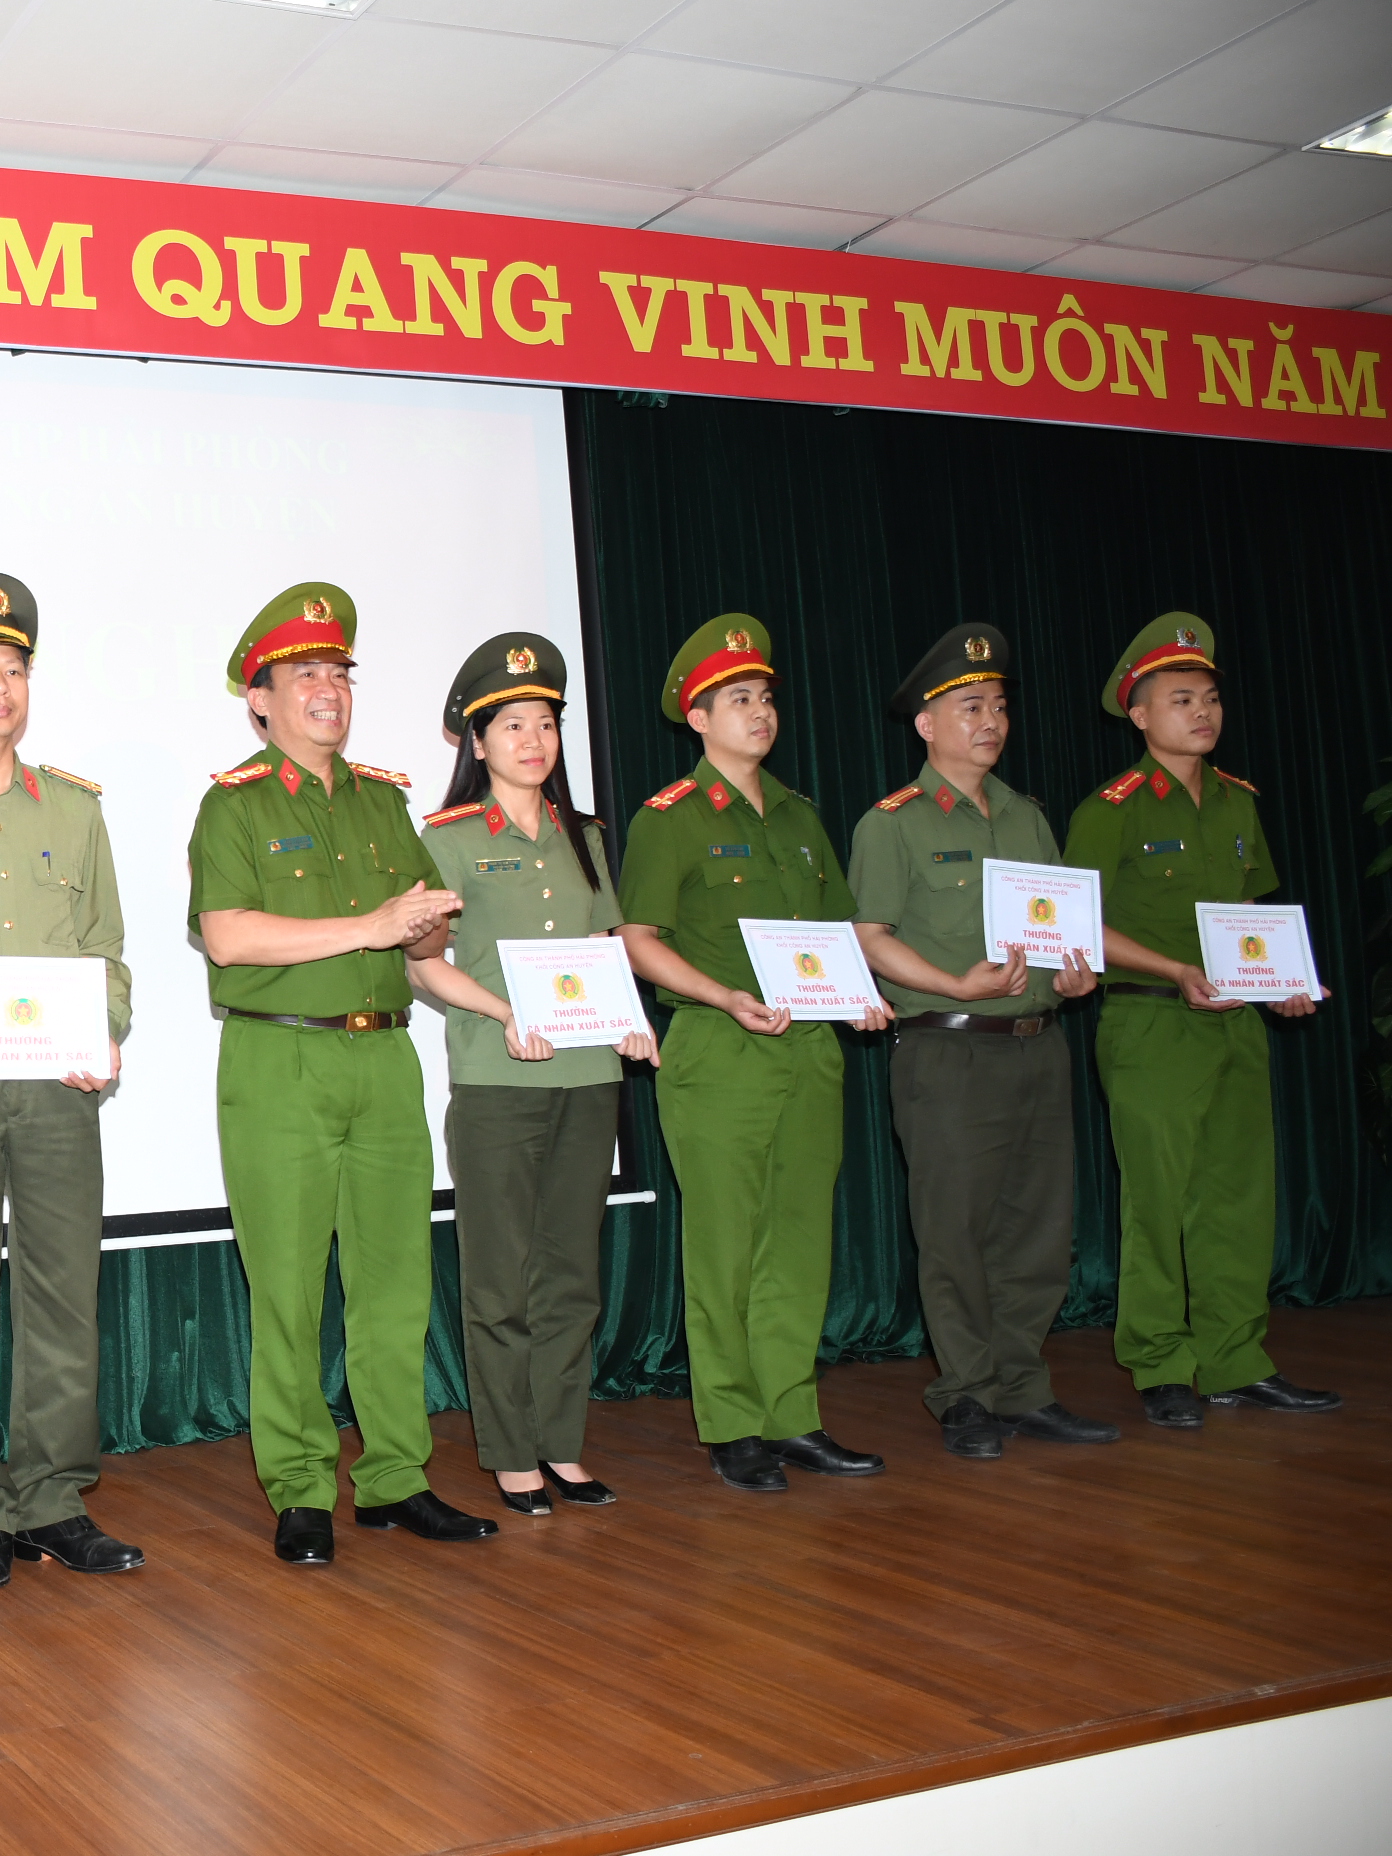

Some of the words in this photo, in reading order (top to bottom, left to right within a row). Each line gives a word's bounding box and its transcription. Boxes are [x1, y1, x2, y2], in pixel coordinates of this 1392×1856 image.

[131, 229, 572, 346] QUANG
[599, 271, 875, 373] VINH
[894, 294, 1168, 399] MUÔN
[1193, 321, 1387, 419] NĂM
[1023, 929, 1062, 940] THƯỞNG
[1237, 965, 1275, 975] THƯỞNG
[796, 983, 836, 992] THƯỞNG
[1215, 978, 1225, 987] CÁ
[1228, 978, 1254, 987] NHÂN
[553, 1006, 596, 1018] THƯỞNG
